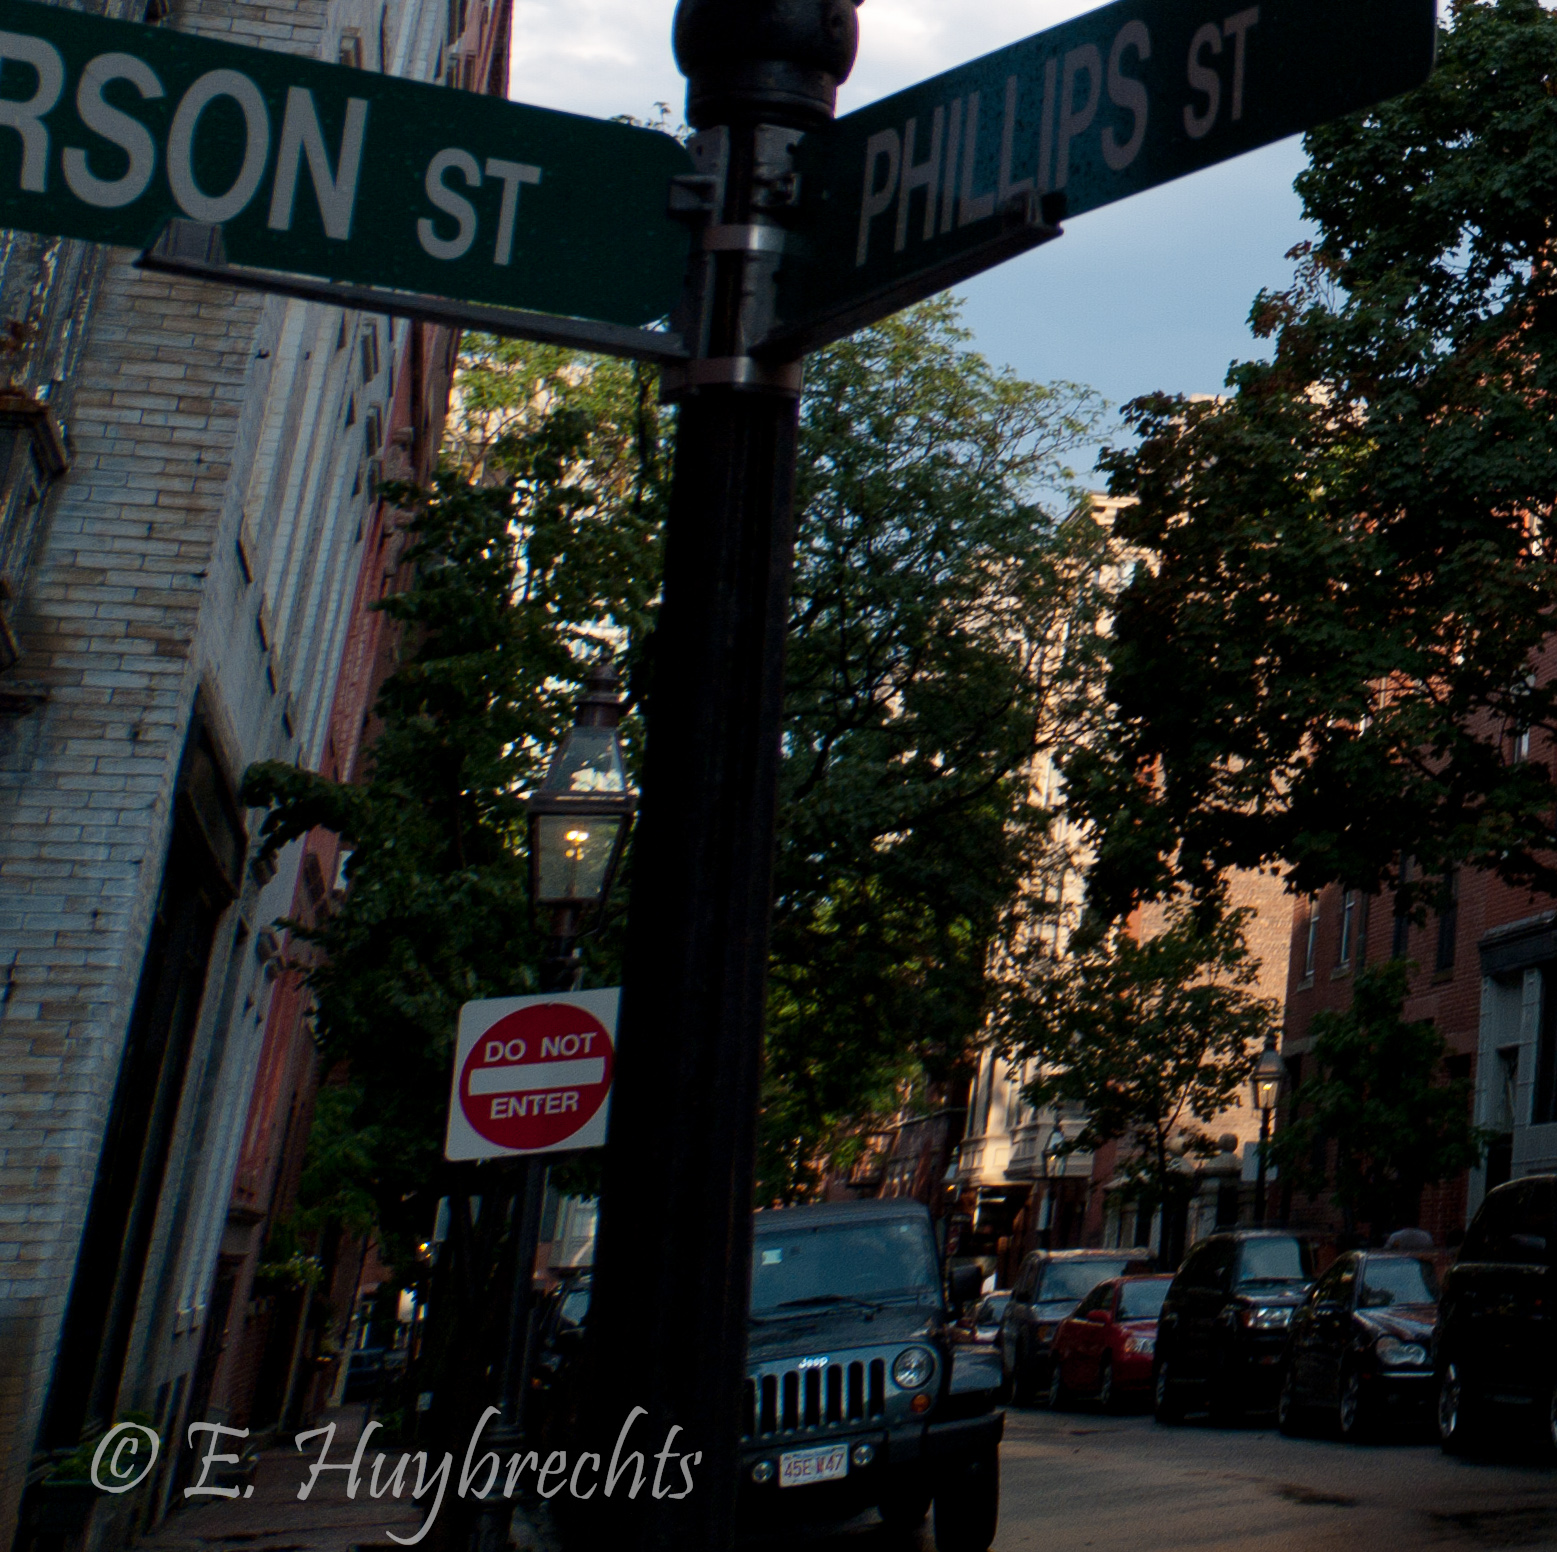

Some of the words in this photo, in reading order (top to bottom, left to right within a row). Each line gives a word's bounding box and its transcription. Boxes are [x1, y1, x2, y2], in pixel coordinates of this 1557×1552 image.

[855, 20, 1151, 267] PHILLIPS
[1183, 5, 1260, 138] ST
[417, 148, 542, 266] ST
[484, 1038, 526, 1063] DO
[540, 1031, 598, 1058] NOT
[490, 1091, 579, 1120] ENTER
[798, 1356, 829, 1370] Jeep
[785, 1458, 812, 1478] 45E
